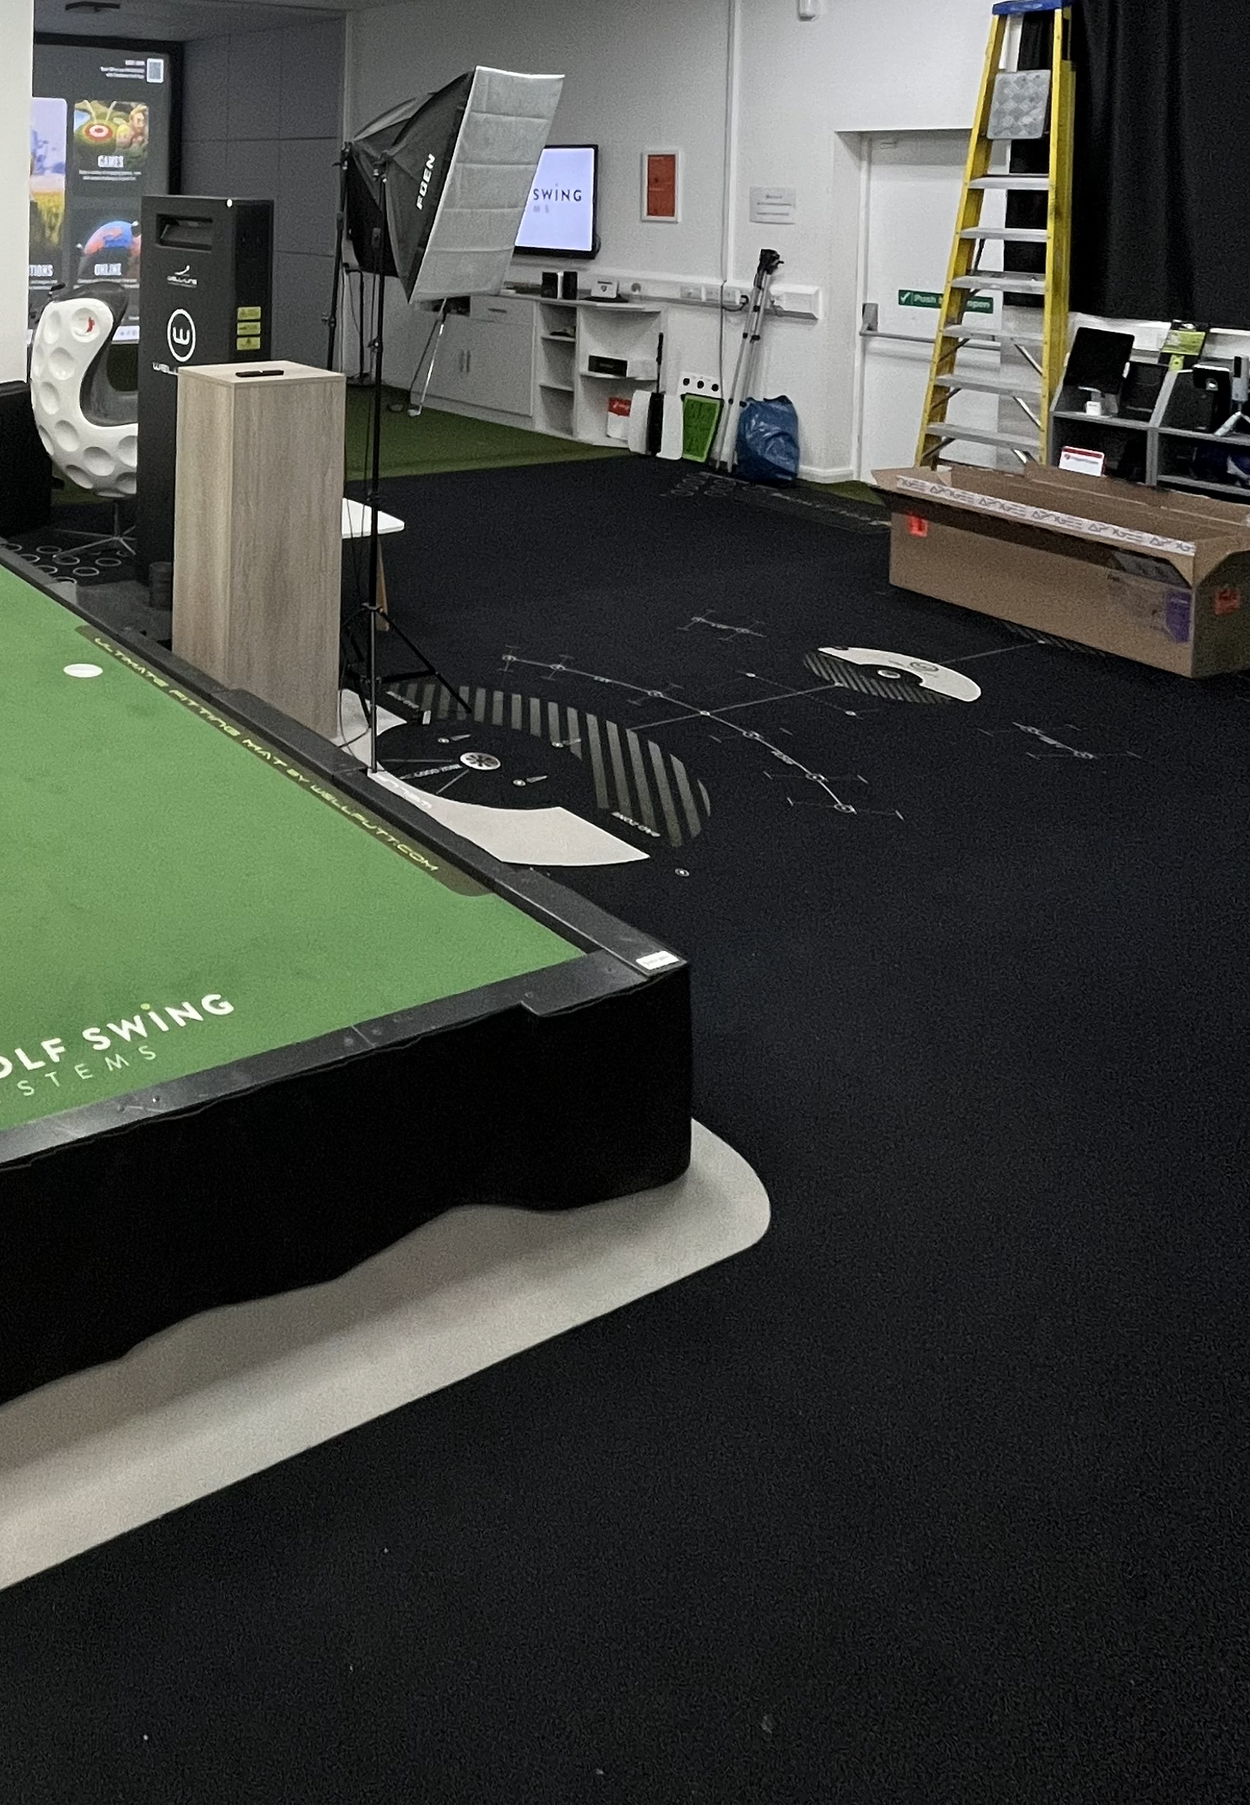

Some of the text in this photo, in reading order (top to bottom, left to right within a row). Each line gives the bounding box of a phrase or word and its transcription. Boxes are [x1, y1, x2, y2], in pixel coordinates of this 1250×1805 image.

[29, 264, 53, 277] TIONS
[914, 294, 936, 304] Push
[967, 300, 990, 309] open
[95, 638, 438, 872] ULTIMATE FITTING MAT BY WELLPUTT.COM
